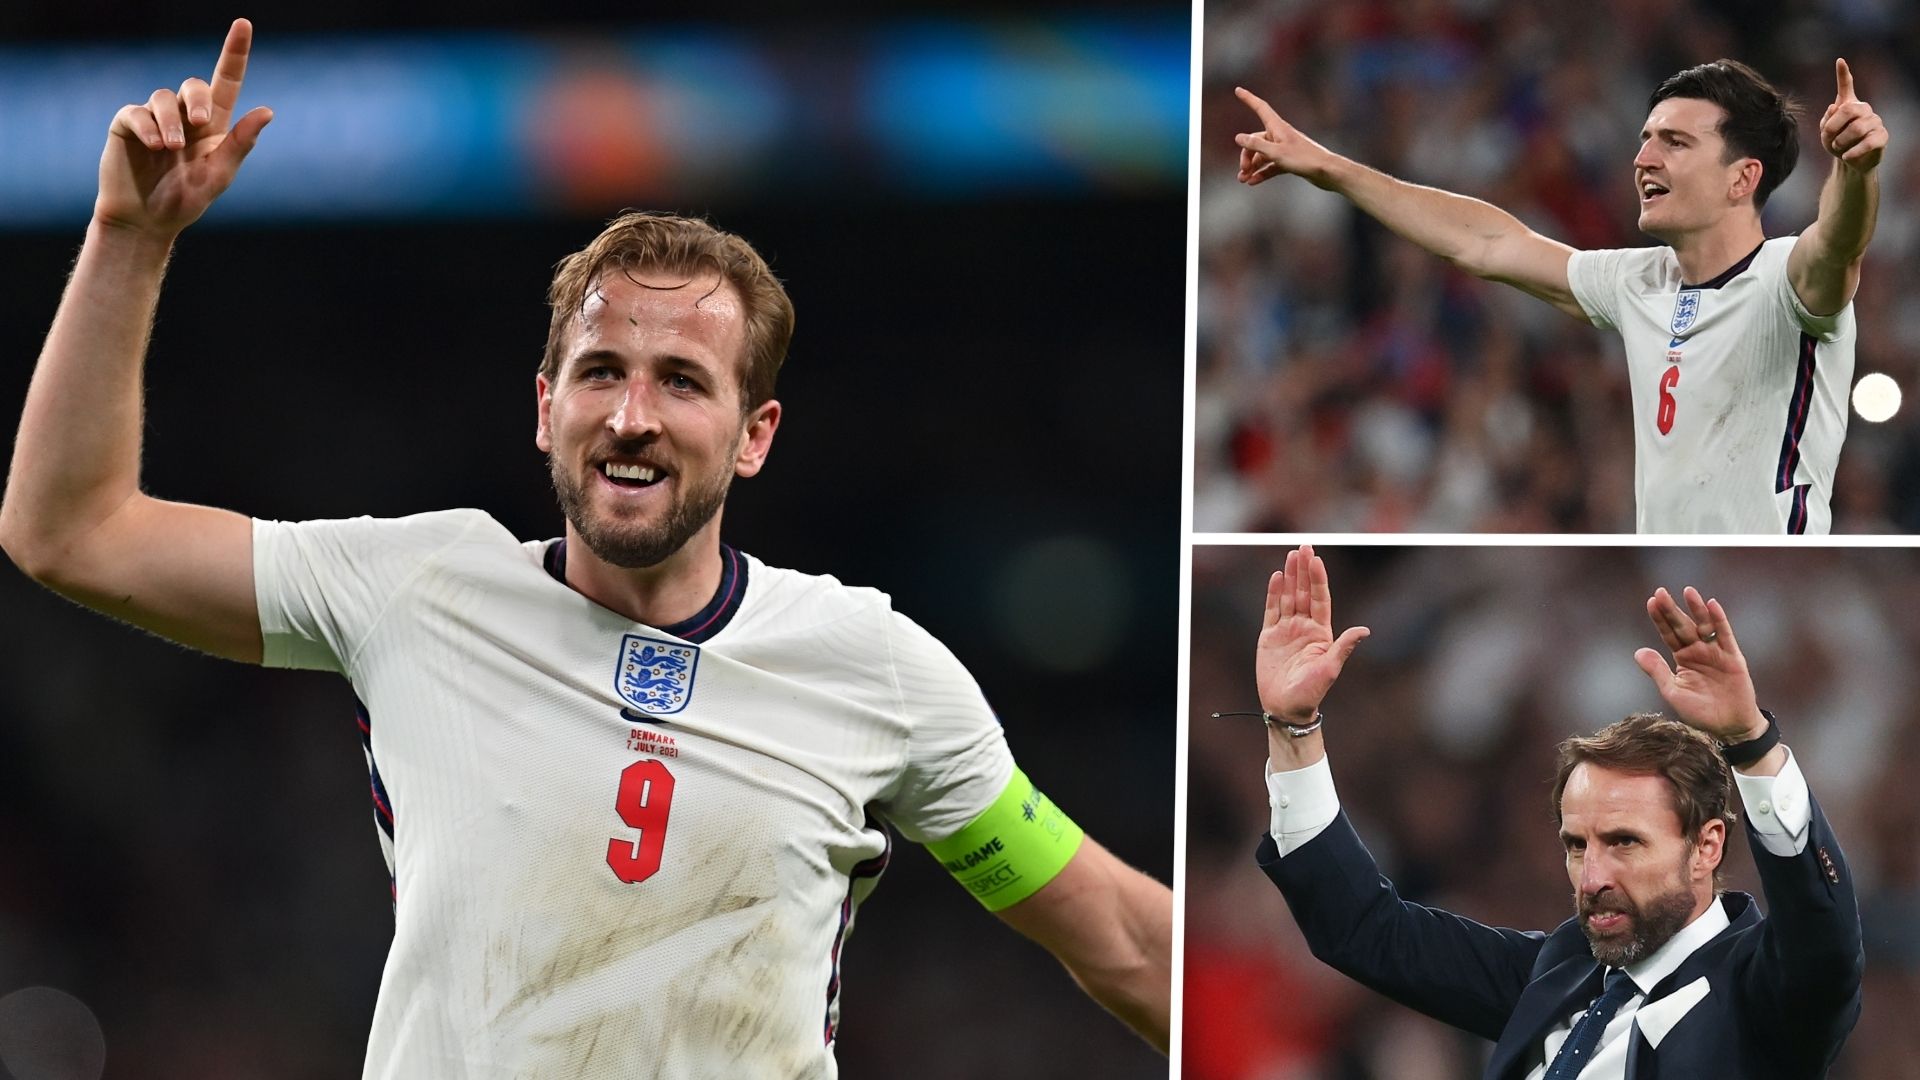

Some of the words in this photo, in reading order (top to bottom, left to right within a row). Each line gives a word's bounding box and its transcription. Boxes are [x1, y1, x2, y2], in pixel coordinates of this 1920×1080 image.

[1657, 365, 1680, 436] 6
[626, 739, 632, 750] 7
[633, 741, 656, 755] JULY
[659, 746, 679, 758] 2021
[630, 728, 676, 746] DENMARK
[606, 758, 676, 884] 9
[966, 863, 1016, 893] ESPECT
